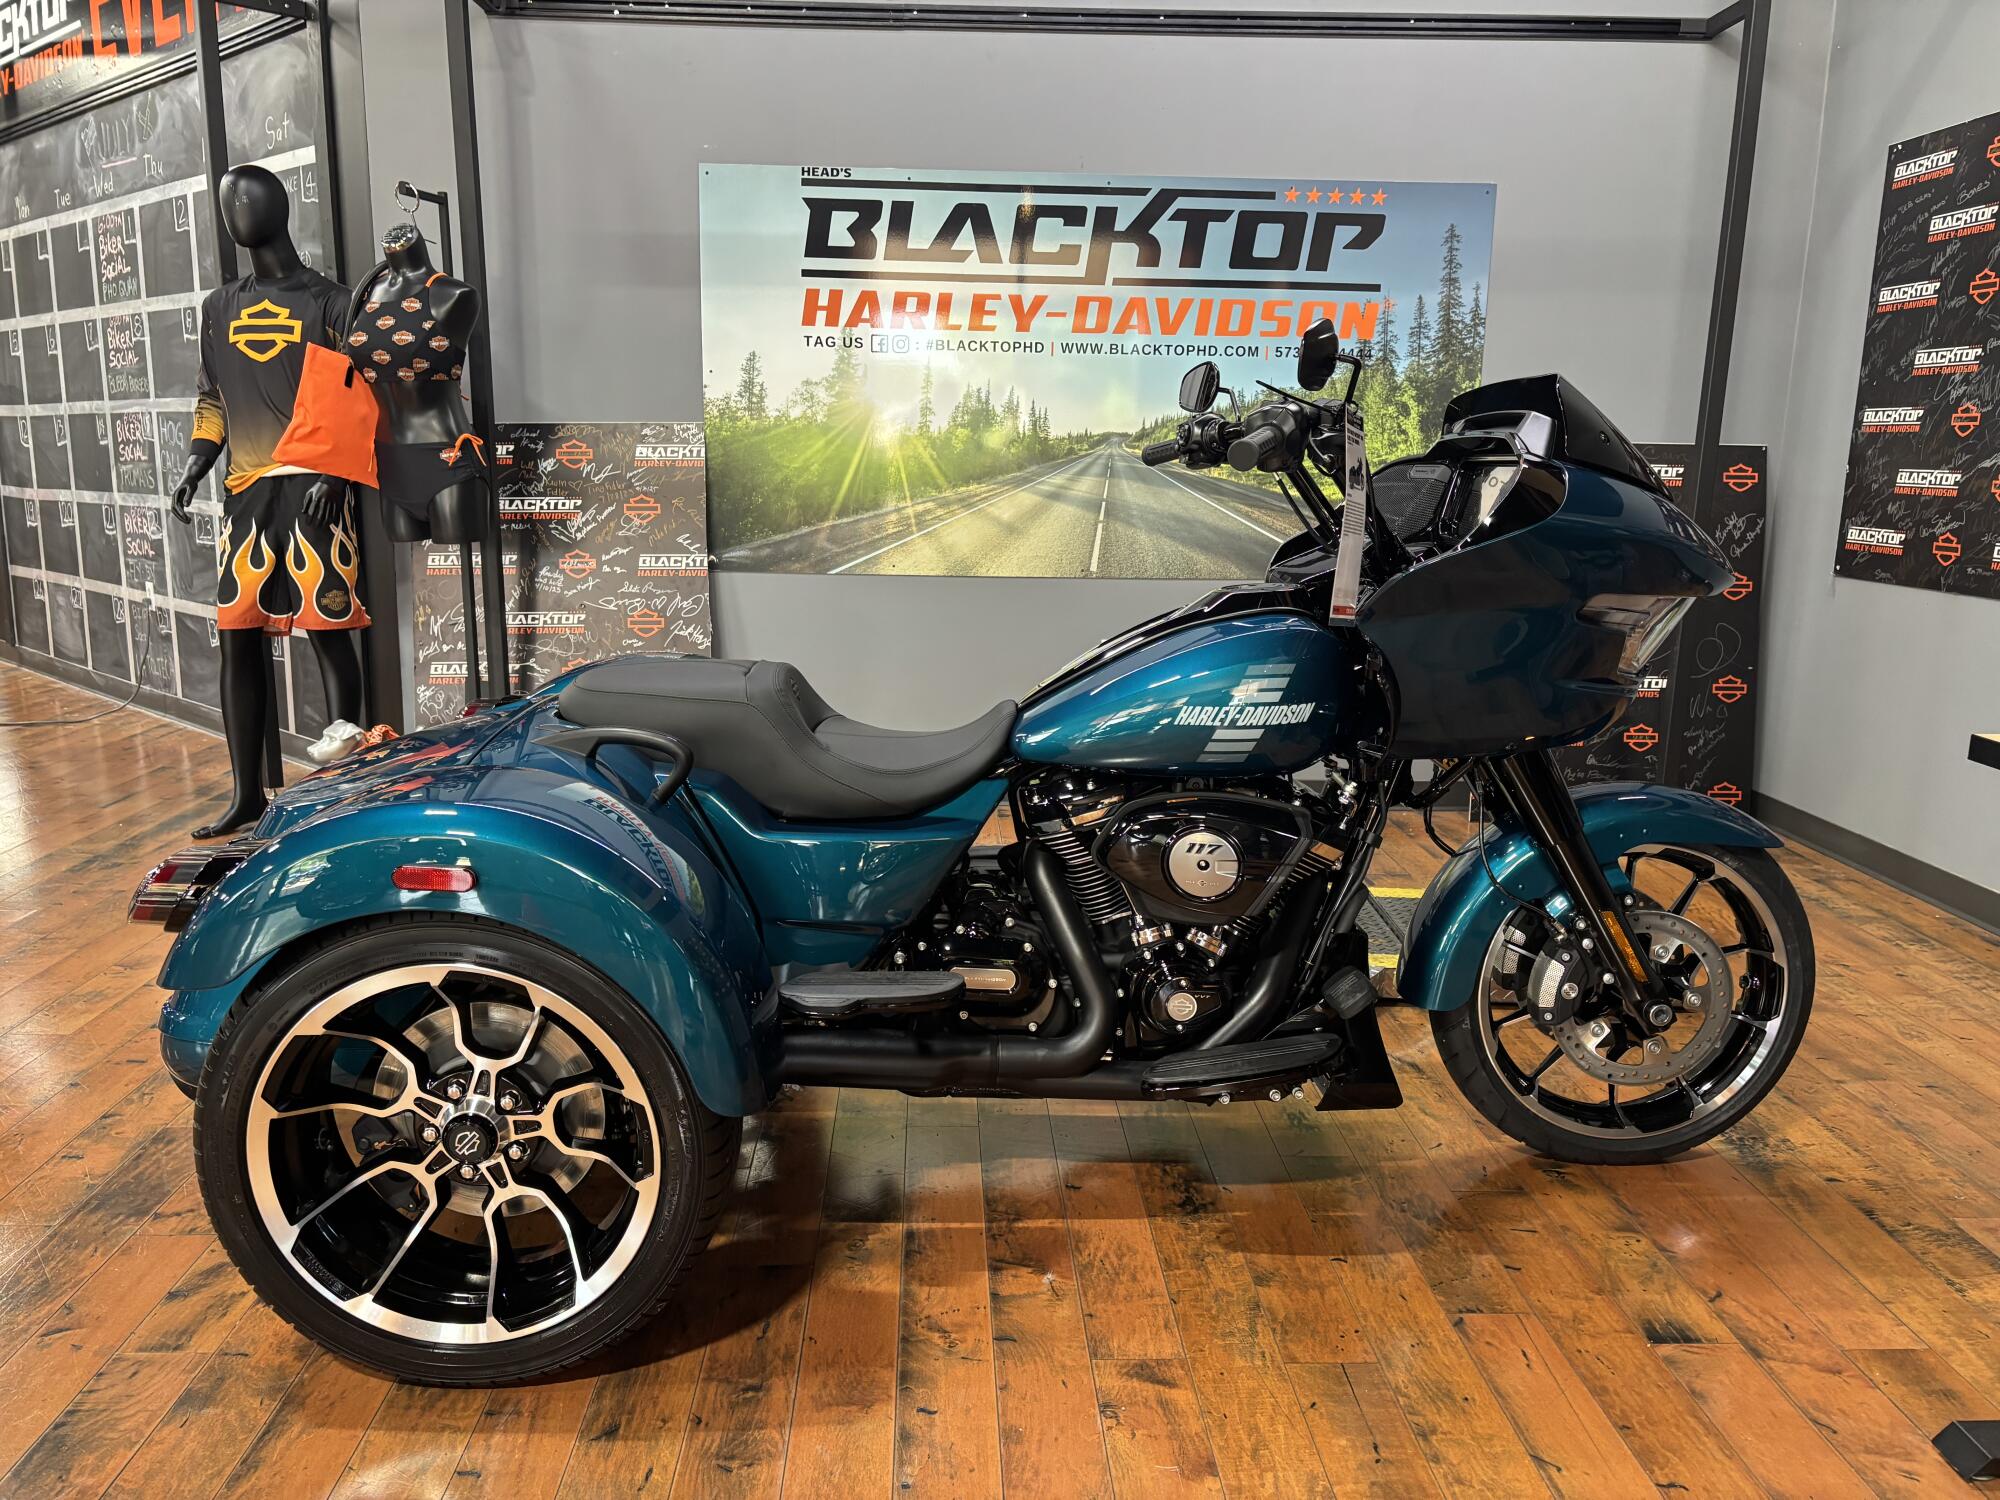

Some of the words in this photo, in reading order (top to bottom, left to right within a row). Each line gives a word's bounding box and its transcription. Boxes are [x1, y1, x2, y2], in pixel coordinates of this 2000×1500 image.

[265, 111, 290, 150] Sat
[143, 153, 164, 176] Thu
[801, 167, 852, 178] HEAD'S
[1894, 149, 1959, 179] BLACKTOP
[93, 170, 115, 198] Wed
[305, 171, 316, 196] 4
[1892, 166, 1955, 190] HARLEY-DAVIDSON
[54, 188, 72, 209] Tue
[178, 199, 186, 225] 2
[1929, 204, 1999, 232] BLACKTOP
[801, 190, 1387, 284] BLACKTOP
[1927, 222, 1996, 244] HARLEY-DAVIDSON
[1879, 281, 1941, 302] BLACKTOP
[801, 288, 1380, 340] HARLEY-DAVIDSON
[1877, 297, 1938, 314] HARLEY-DAVIDSON
[133, 315, 143, 337] 8
[12, 331, 18, 351] 5
[49, 327, 56, 350] 6
[804, 335, 836, 348] TAG
[842, 336, 864, 349] US
[926, 339, 1045, 353] #BLACKTOPHD
[1060, 342, 1260, 358] WWW.BLACKTOPHD.COM
[1914, 347, 1982, 366] BLACKTOP
[1911, 364, 1979, 377] HARLEY-DAVIDSON
[1862, 408, 1925, 424] BLACKTOP
[159, 415, 185, 451] HOG
[1860, 424, 1921, 434] HARLEY-DAVIDSON
[160, 449, 185, 473] CALL
[635, 446, 705, 459] BLACKT
[1896, 471, 1962, 487] BLACKTOP
[1894, 486, 1958, 498] HARLEY-DAVIDSON
[1847, 528, 1906, 545] BLACKTOP
[1845, 542, 1903, 557] HARLEY-DAVIDSON
[638, 555, 709, 568] BLACKT
[506, 613, 587, 626] LACKTOP
[1174, 702, 1316, 727] HARLEY-DAVIDSON
[1185, 842, 1225, 855] 117
